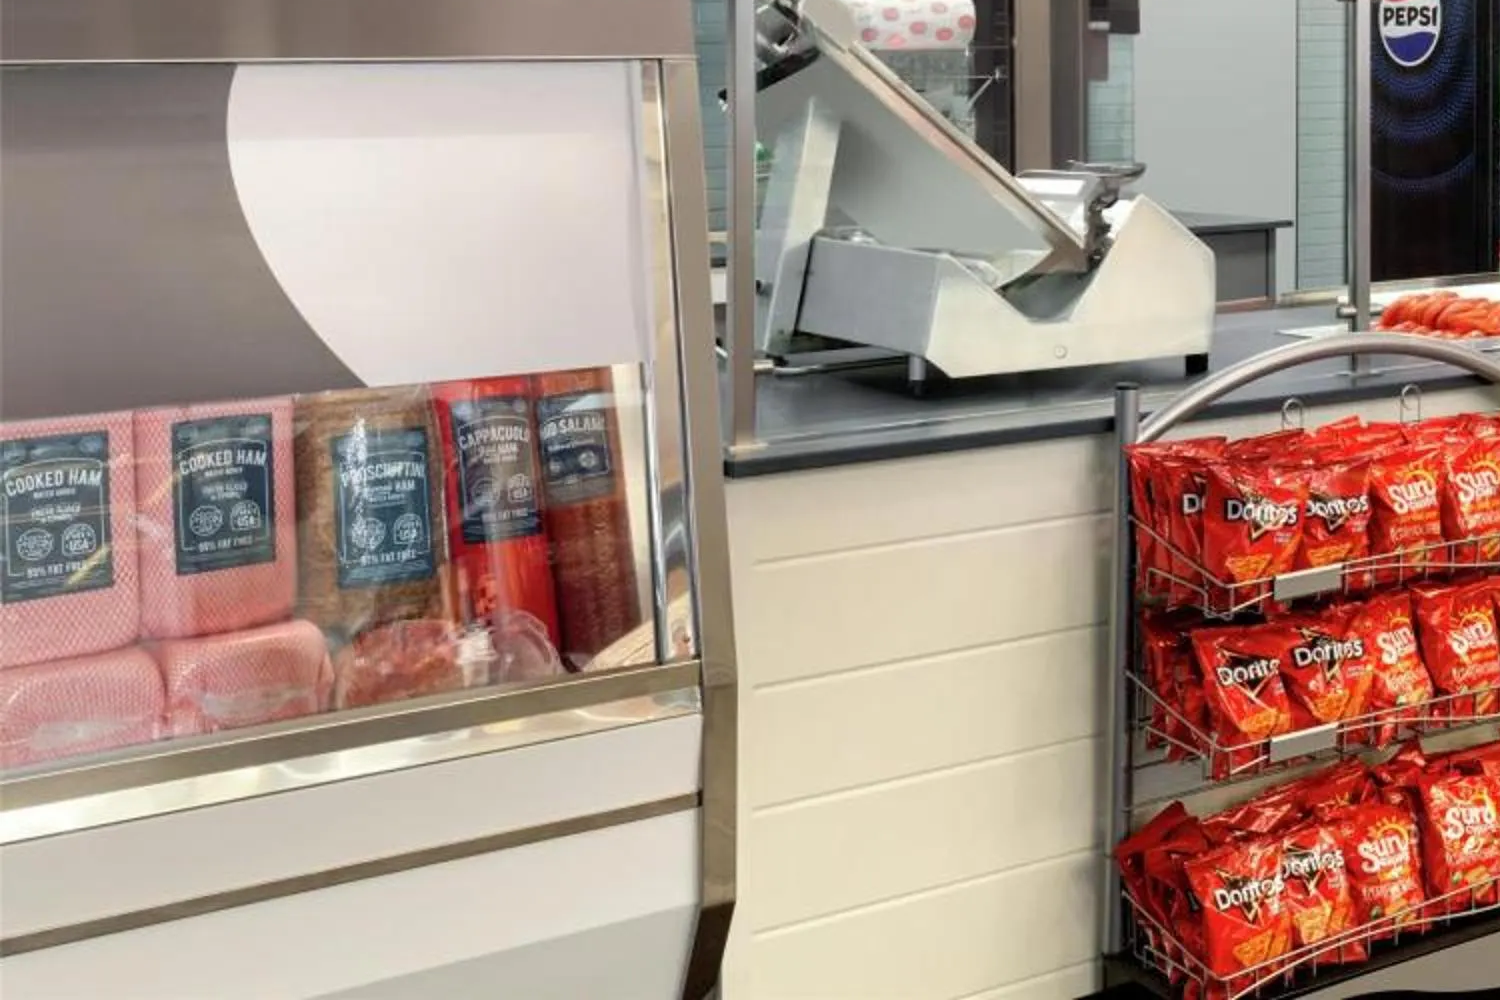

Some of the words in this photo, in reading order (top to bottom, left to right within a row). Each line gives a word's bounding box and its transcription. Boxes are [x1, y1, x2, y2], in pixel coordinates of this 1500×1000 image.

[1383, 5, 1437, 27] PEPSI
[180, 450, 233, 476] COOKED
[236, 449, 267, 467] HAM
[5, 470, 64, 497] COOKED
[69, 467, 102, 487] HAM
[1388, 480, 1437, 514] Sun
[1227, 499, 1298, 525] Doritos
[1295, 639, 1363, 666] Doritos
[1451, 622, 1492, 654] Sun
[1217, 658, 1280, 685] Dorito
[1445, 803, 1497, 839] Sun
[1357, 833, 1408, 873] Sun
[1214, 876, 1285, 910] Doritos
